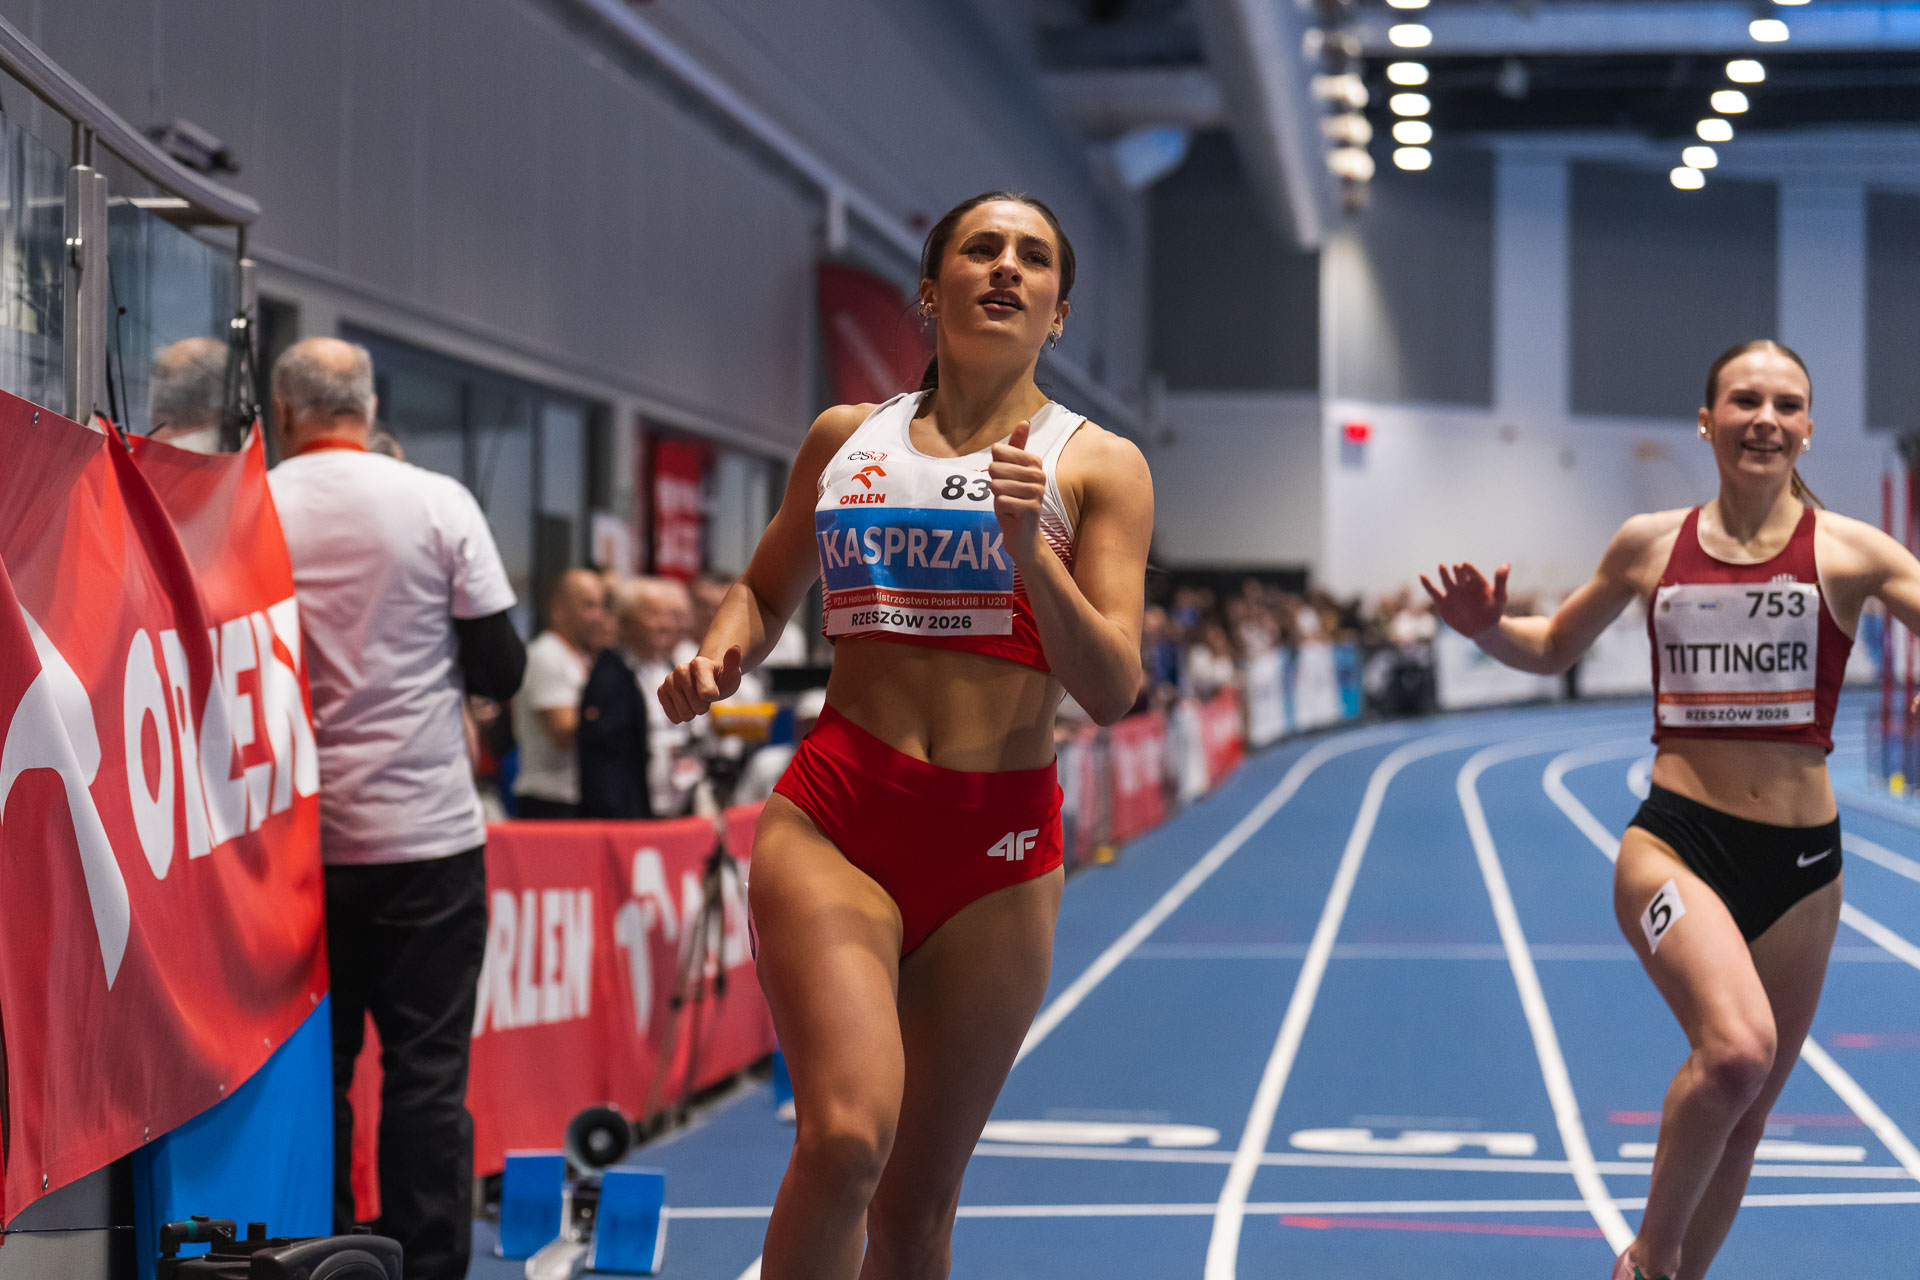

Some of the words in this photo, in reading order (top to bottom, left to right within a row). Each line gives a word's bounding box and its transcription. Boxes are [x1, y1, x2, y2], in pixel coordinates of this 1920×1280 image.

[839, 493, 887, 505] ORLEN
[941, 474, 993, 502] 83
[821, 525, 1007, 571] KASPRZAK
[833, 596, 848, 606] PZLA
[872, 592, 929, 605] Mistrzostwa
[931, 596, 960, 607] Polski
[962, 596, 979, 606] U18
[987, 596, 1007, 606] U20
[1745, 591, 1806, 618] 753
[851, 609, 925, 628] RZESZÓW
[928, 615, 972, 630] 2026
[1664, 641, 1808, 674] TITTINGER
[1685, 705, 1753, 723] RZESZÓW
[1755, 707, 1790, 721] 2026
[986, 828, 1039, 862] 4F
[1649, 891, 1672, 936] 5
[472, 887, 593, 1037] RLEN
